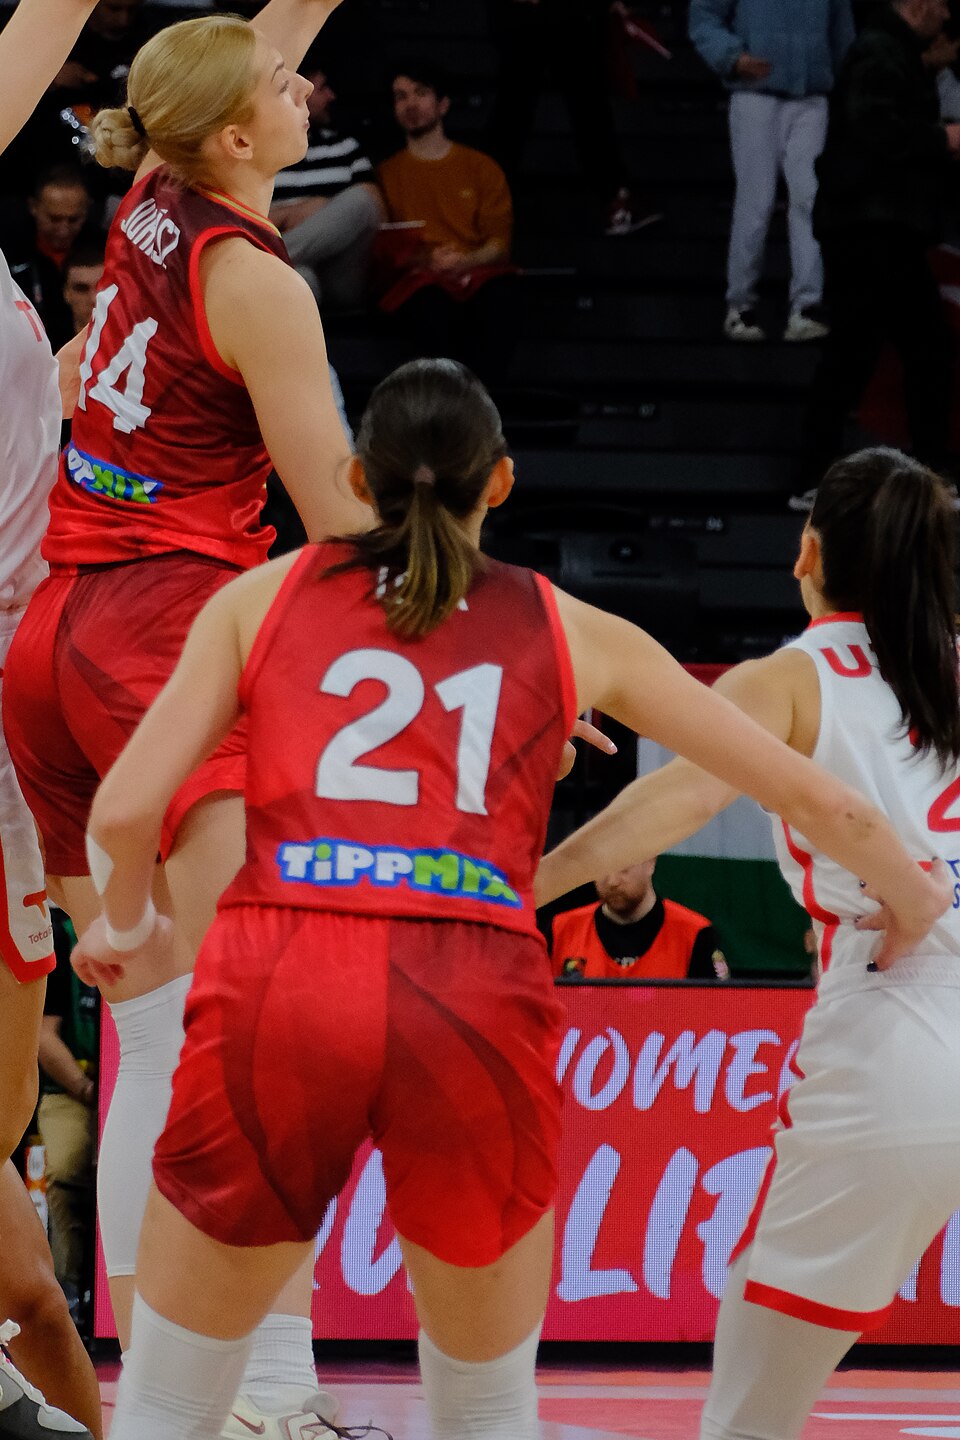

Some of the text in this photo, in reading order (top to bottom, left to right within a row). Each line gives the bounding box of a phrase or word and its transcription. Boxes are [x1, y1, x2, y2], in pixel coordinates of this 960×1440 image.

[77, 283, 159, 434] 14
[315, 648, 503, 816] 21
[555, 1027, 804, 1114] OME
